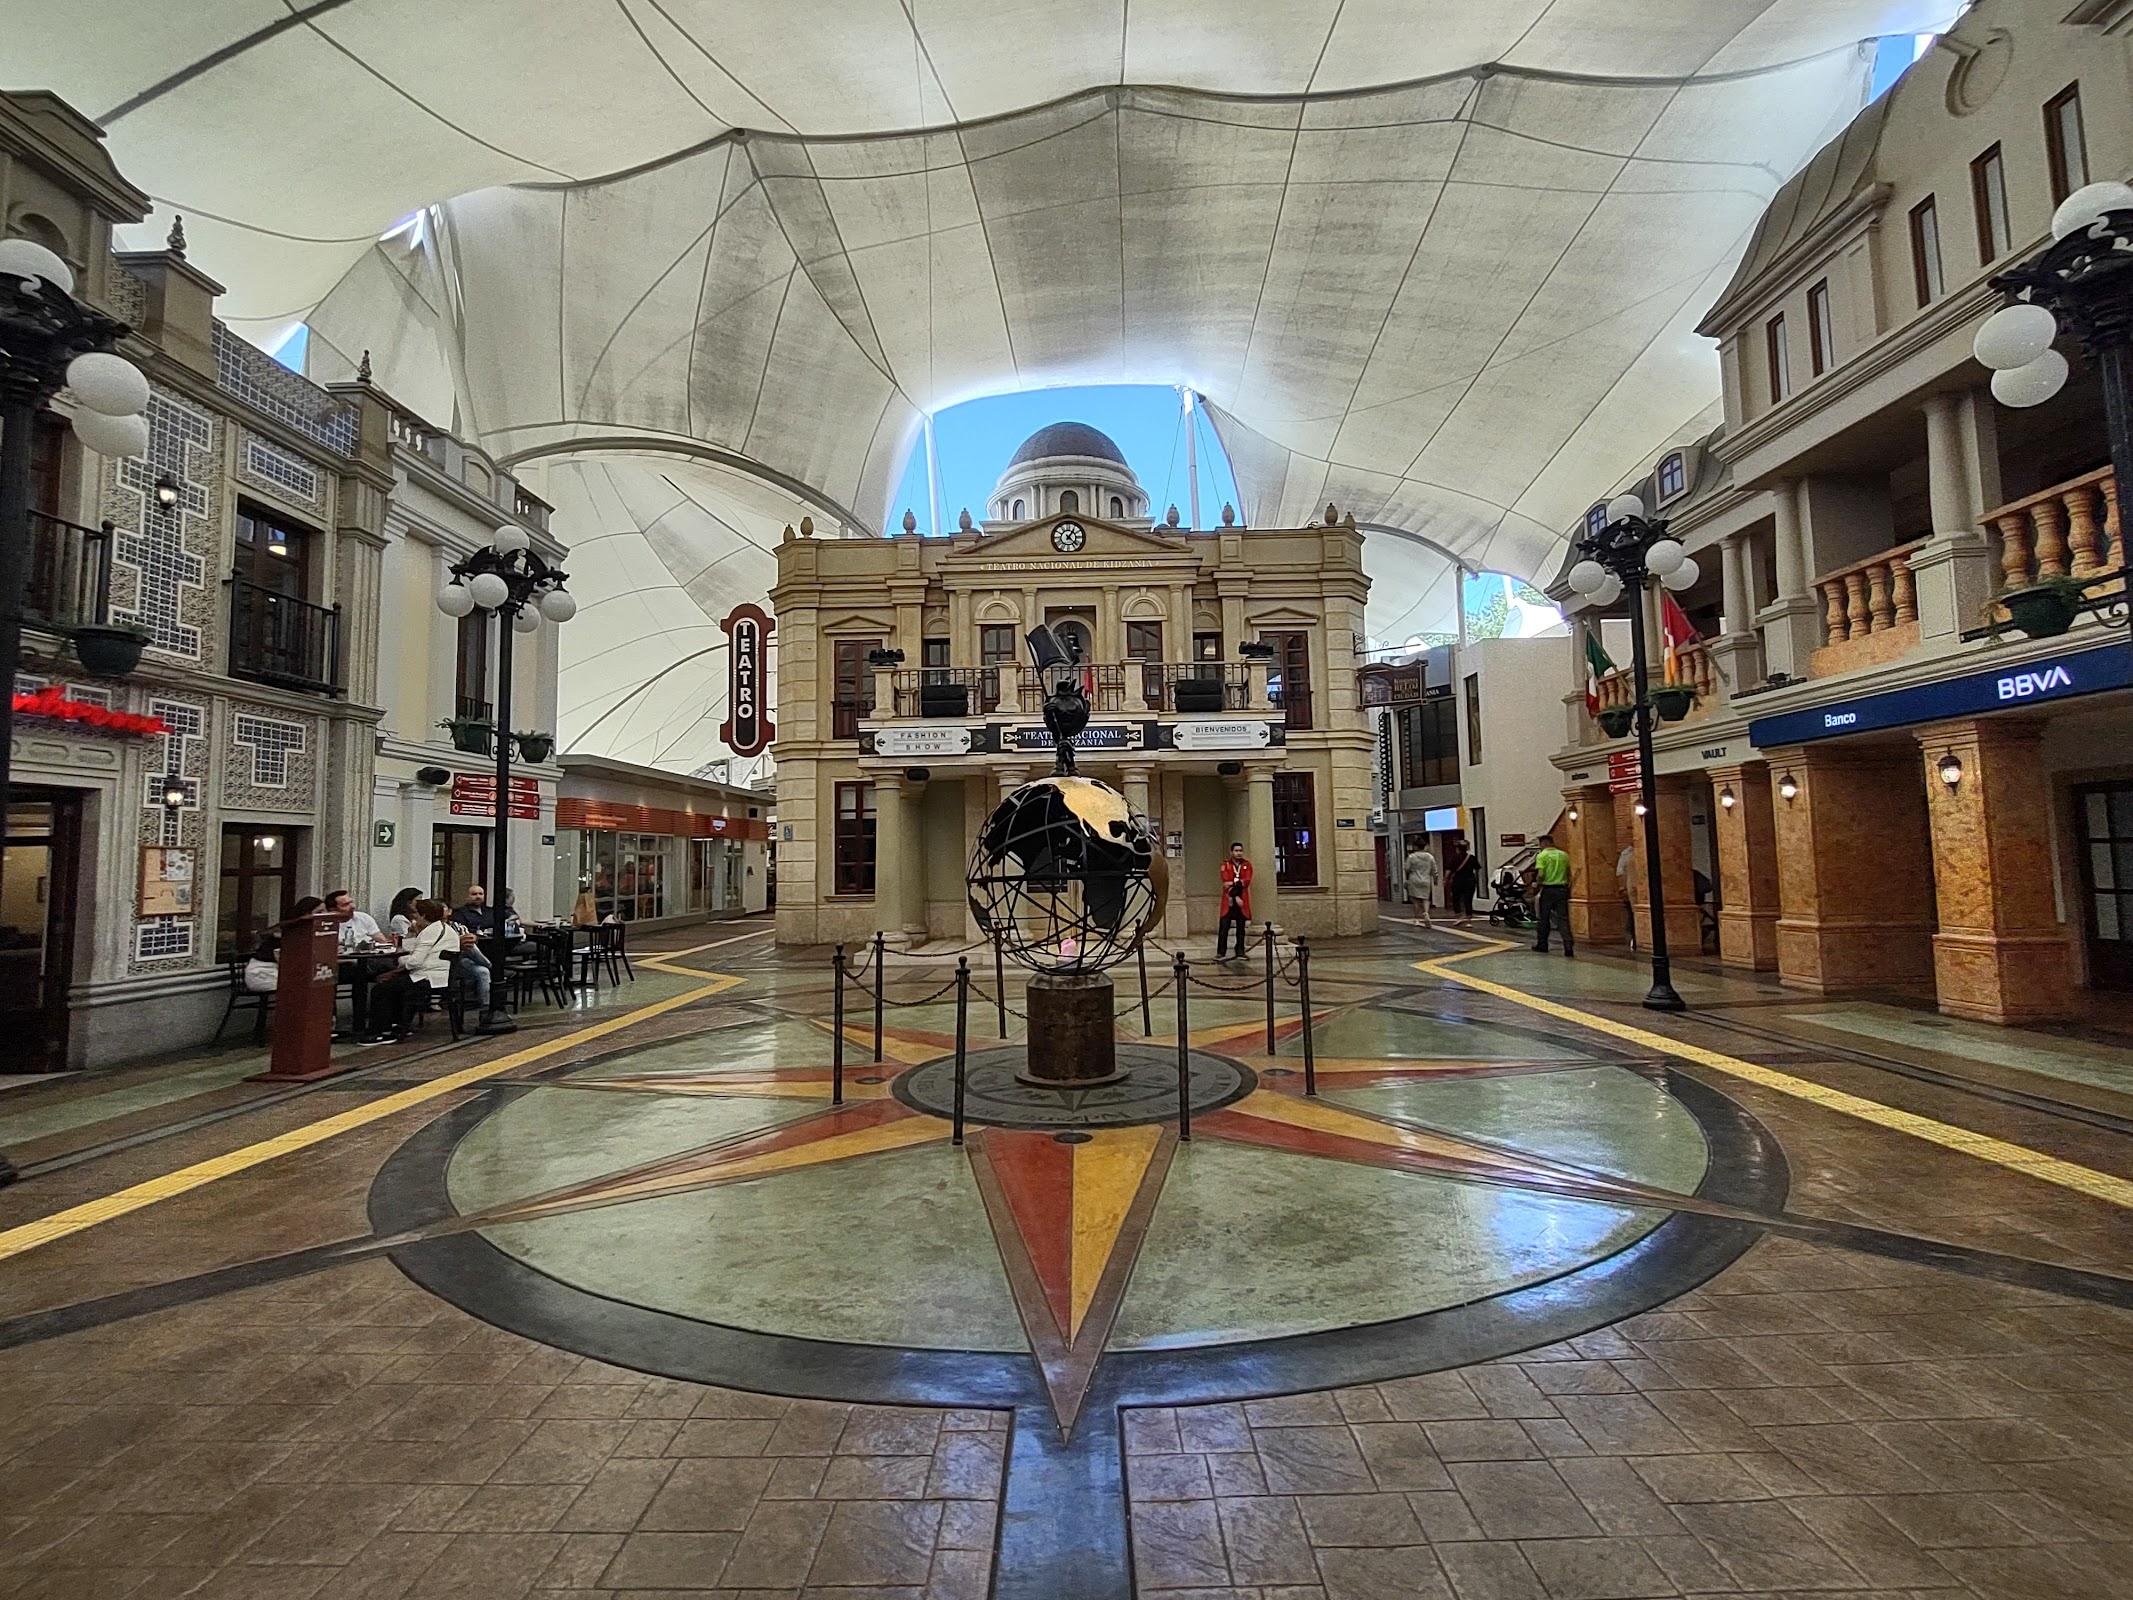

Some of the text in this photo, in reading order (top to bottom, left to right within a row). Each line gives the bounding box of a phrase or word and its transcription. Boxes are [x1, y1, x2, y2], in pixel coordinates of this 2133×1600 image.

[986, 562, 1026, 571] TEATRO
[1030, 561, 1083, 570] NACIONAL
[1103, 559, 1153, 568] KIDZANIA
[738, 622, 753, 719] TEATRO
[1997, 666, 2072, 700] BBVA
[1824, 713, 1857, 727] Banco
[1023, 730, 1121, 740] TEAT ACIONAL
